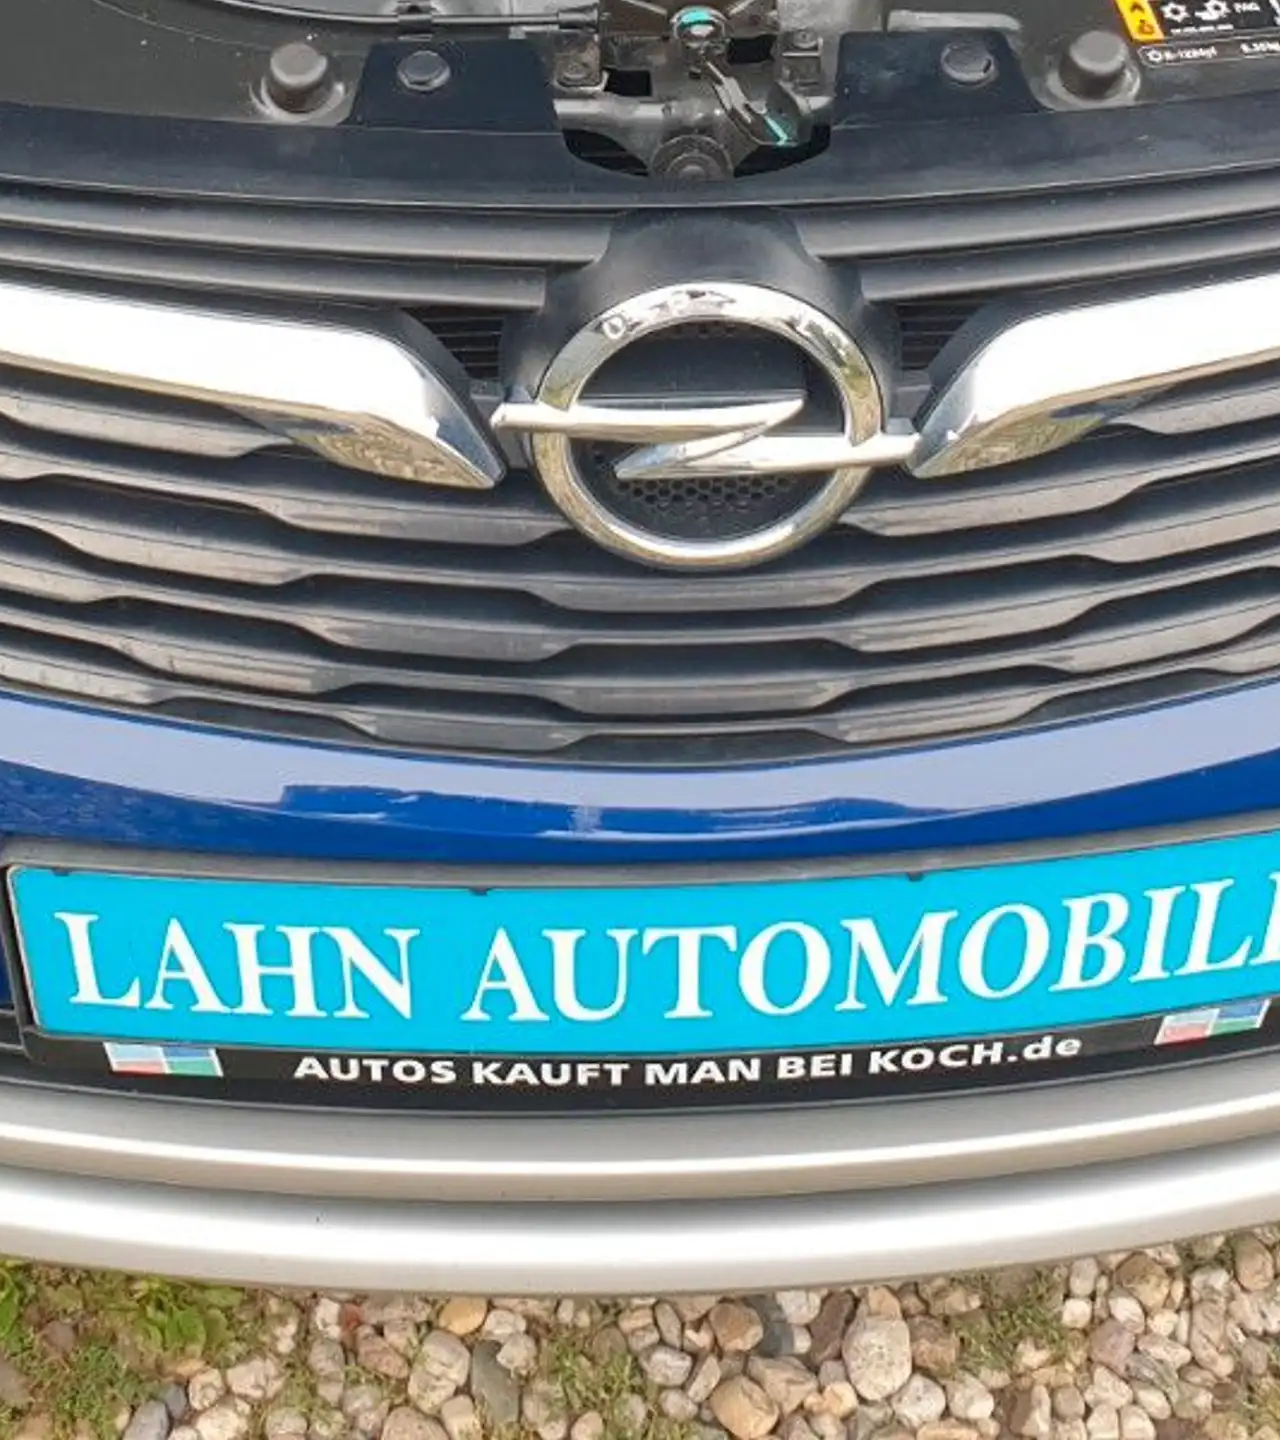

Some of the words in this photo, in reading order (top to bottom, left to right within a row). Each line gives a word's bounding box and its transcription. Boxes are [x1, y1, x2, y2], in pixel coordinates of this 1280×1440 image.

[55, 912, 418, 1018] LAHN
[293, 1056, 457, 1084] AUTOS
[472, 1061, 630, 1086] KAUFT
[645, 1057, 761, 1086] MAN
[777, 1053, 853, 1079] BEI
[868, 1034, 1083, 1074] KOCH.de
